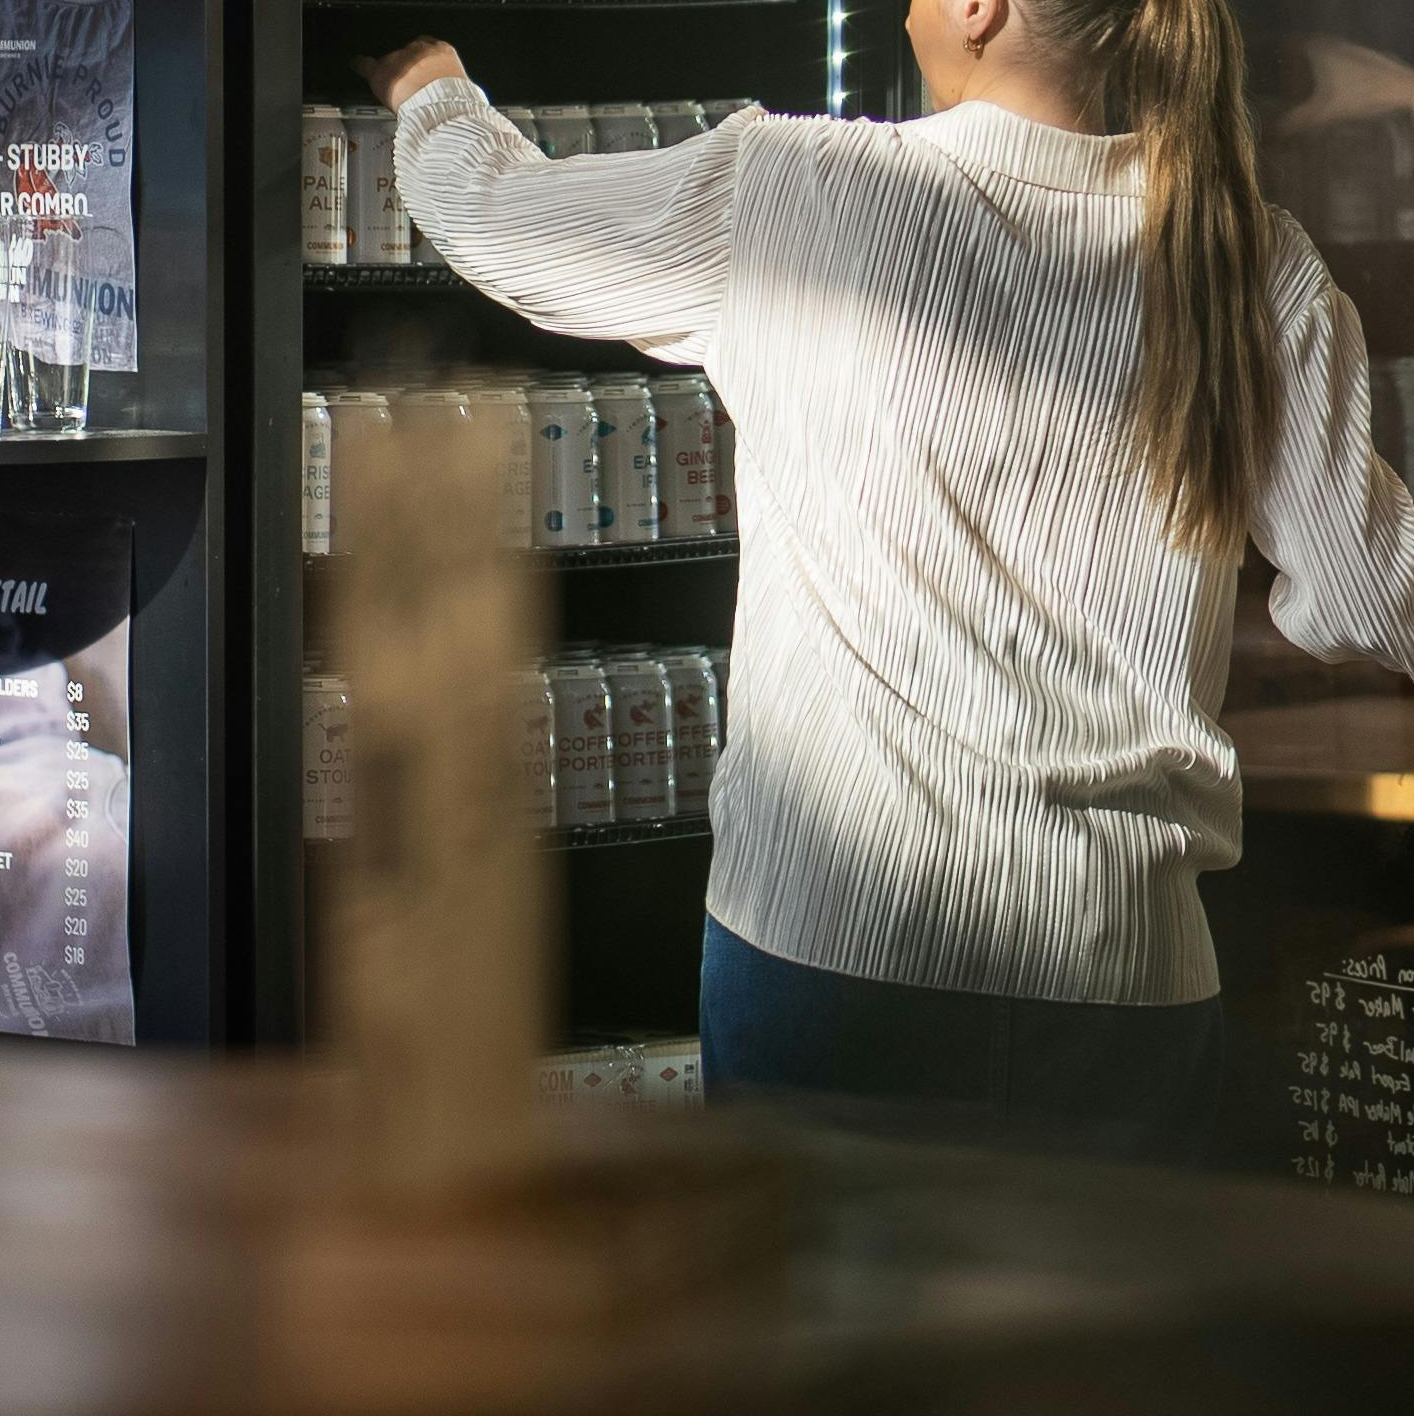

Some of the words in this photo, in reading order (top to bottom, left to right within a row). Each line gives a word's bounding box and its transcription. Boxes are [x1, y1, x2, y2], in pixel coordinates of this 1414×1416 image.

[73, 63, 126, 167] PROUD
[7, 143, 89, 171] STUBBY
[17, 191, 90, 218] COMBO
[309, 196, 342, 211] ALE
[66, 680, 83, 702] $8
[66, 710, 90, 733] $35
[66, 740, 89, 761] $25
[66, 769, 89, 790] $25
[66, 798, 89, 820] $35
[65, 828, 89, 849] $40
[65, 857, 88, 878] $20
[65, 887, 87, 907] $25
[65, 916, 87, 936] $20
[65, 945, 85, 965] $18
